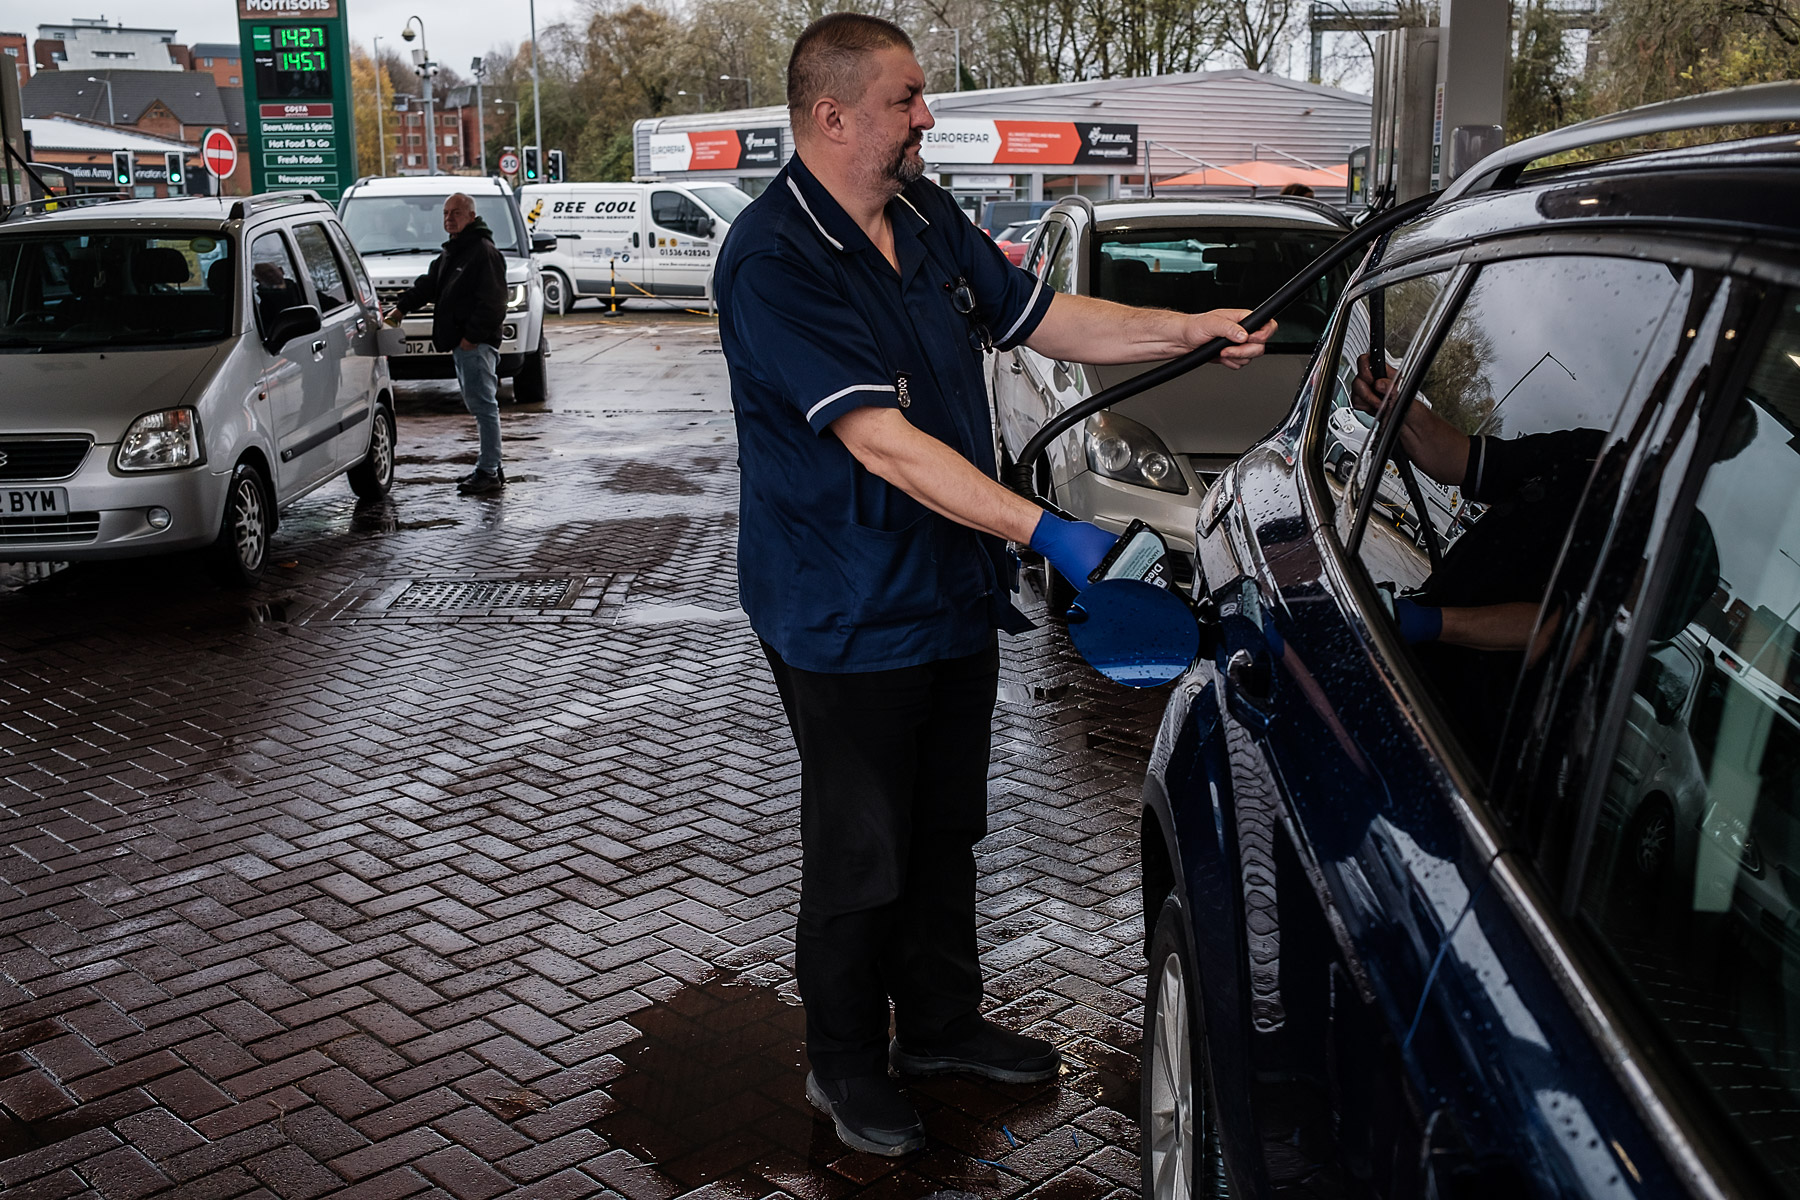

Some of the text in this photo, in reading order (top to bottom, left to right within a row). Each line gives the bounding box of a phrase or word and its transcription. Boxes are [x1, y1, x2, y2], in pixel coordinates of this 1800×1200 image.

[246, 0, 330, 11] Morrisons
[281, 27, 324, 48] 142.7
[283, 51, 326, 71] 145.7
[284, 105, 308, 113] COSTA
[311, 122, 333, 133] Spirits
[926, 132, 990, 143] EUROREPAR
[268, 139, 330, 148] Hot Food To Go
[277, 154, 323, 164] Fresh Foods
[502, 159, 517, 169] 30
[91, 167, 112, 180] Army
[278, 174, 326, 185] Newspapers
[553, 201, 637, 213] BEE COOL
[660, 248, 711, 257] 01536 428243
[405, 342, 424, 354] D12
[9, 490, 56, 512] BYM
[1147, 549, 1160, 564] HAND
[1143, 562, 1164, 585] Dies
